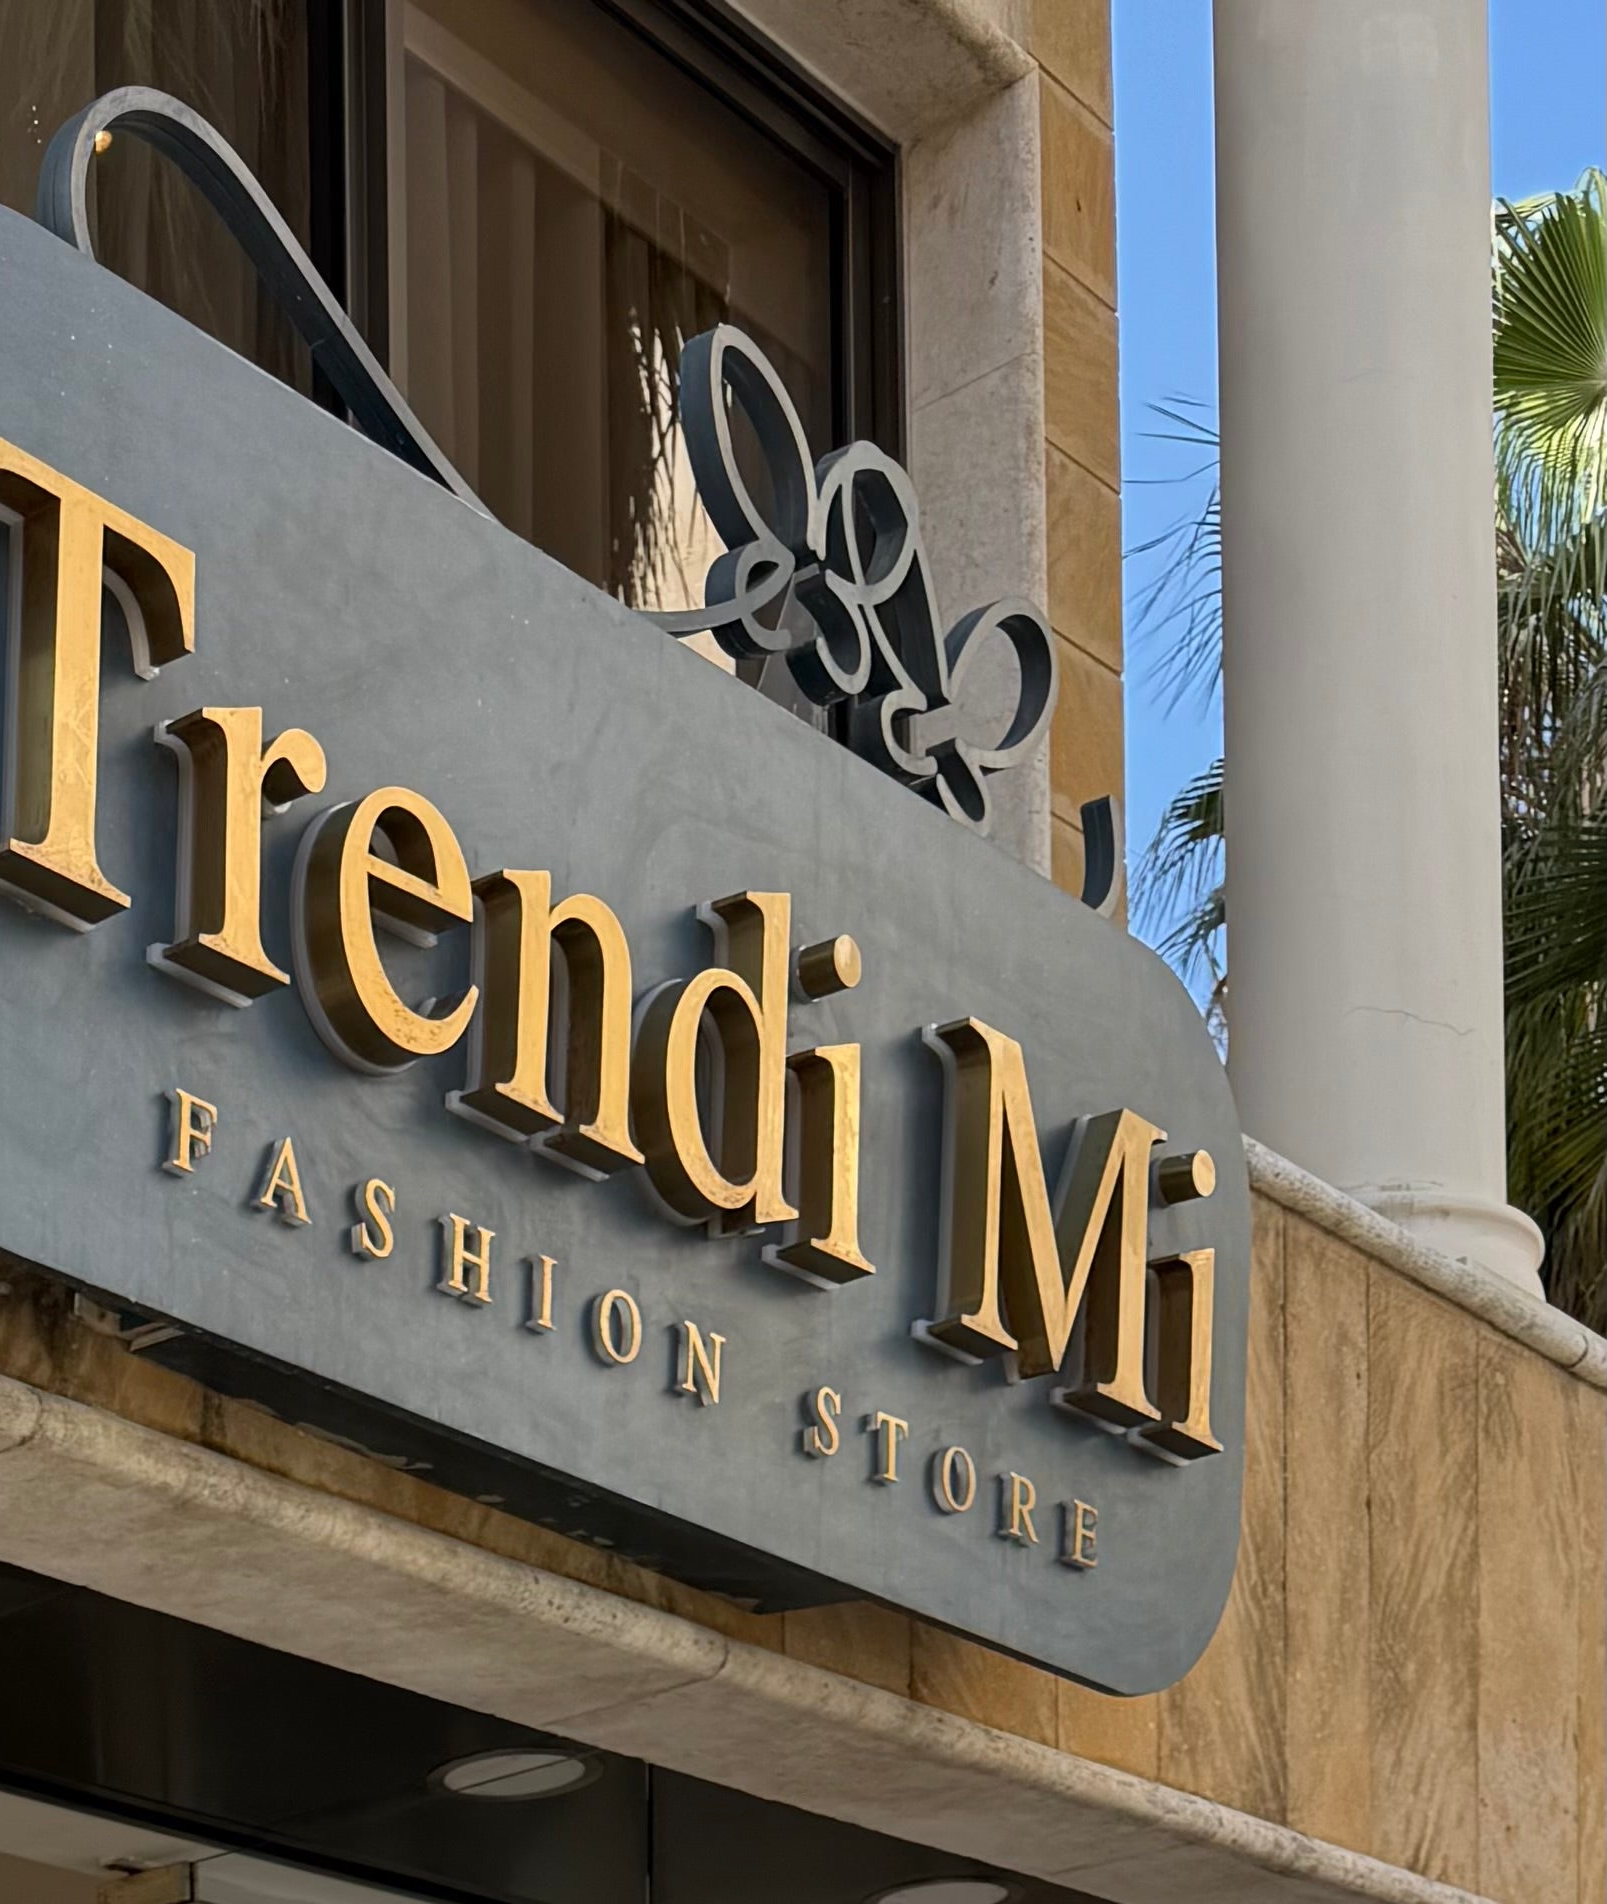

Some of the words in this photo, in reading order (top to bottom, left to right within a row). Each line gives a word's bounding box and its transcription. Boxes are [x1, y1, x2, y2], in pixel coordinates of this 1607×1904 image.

[163, 1086, 727, 1405] FASHION
[803, 1383, 1102, 1571] STORE
[916, 1014, 1226, 1467] Mi
